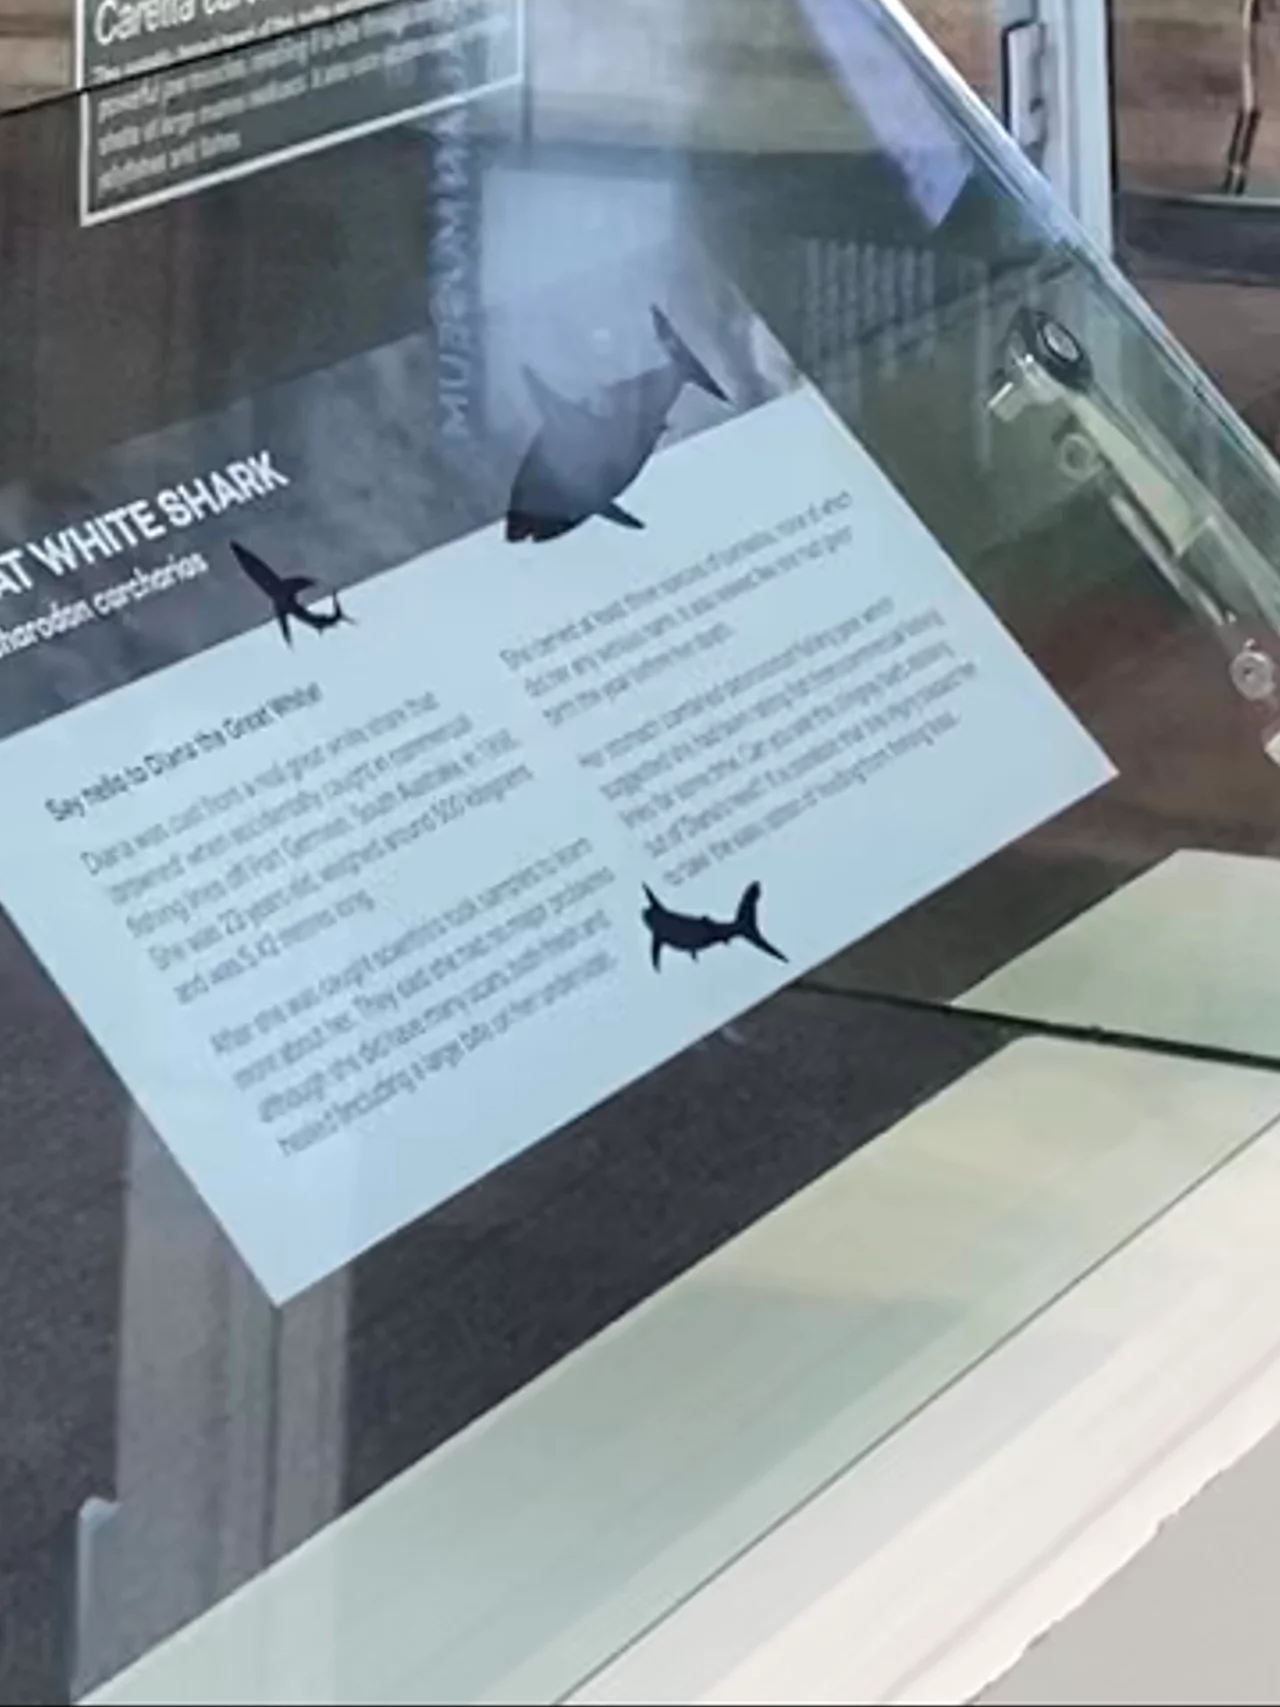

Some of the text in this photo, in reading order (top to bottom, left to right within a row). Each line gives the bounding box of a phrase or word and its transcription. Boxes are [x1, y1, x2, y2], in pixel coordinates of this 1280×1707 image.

[27, 498, 167, 577] WHITE
[158, 449, 290, 530] SHARK
[92, 550, 209, 618] carcharias
[44, 796, 86, 823] Say
